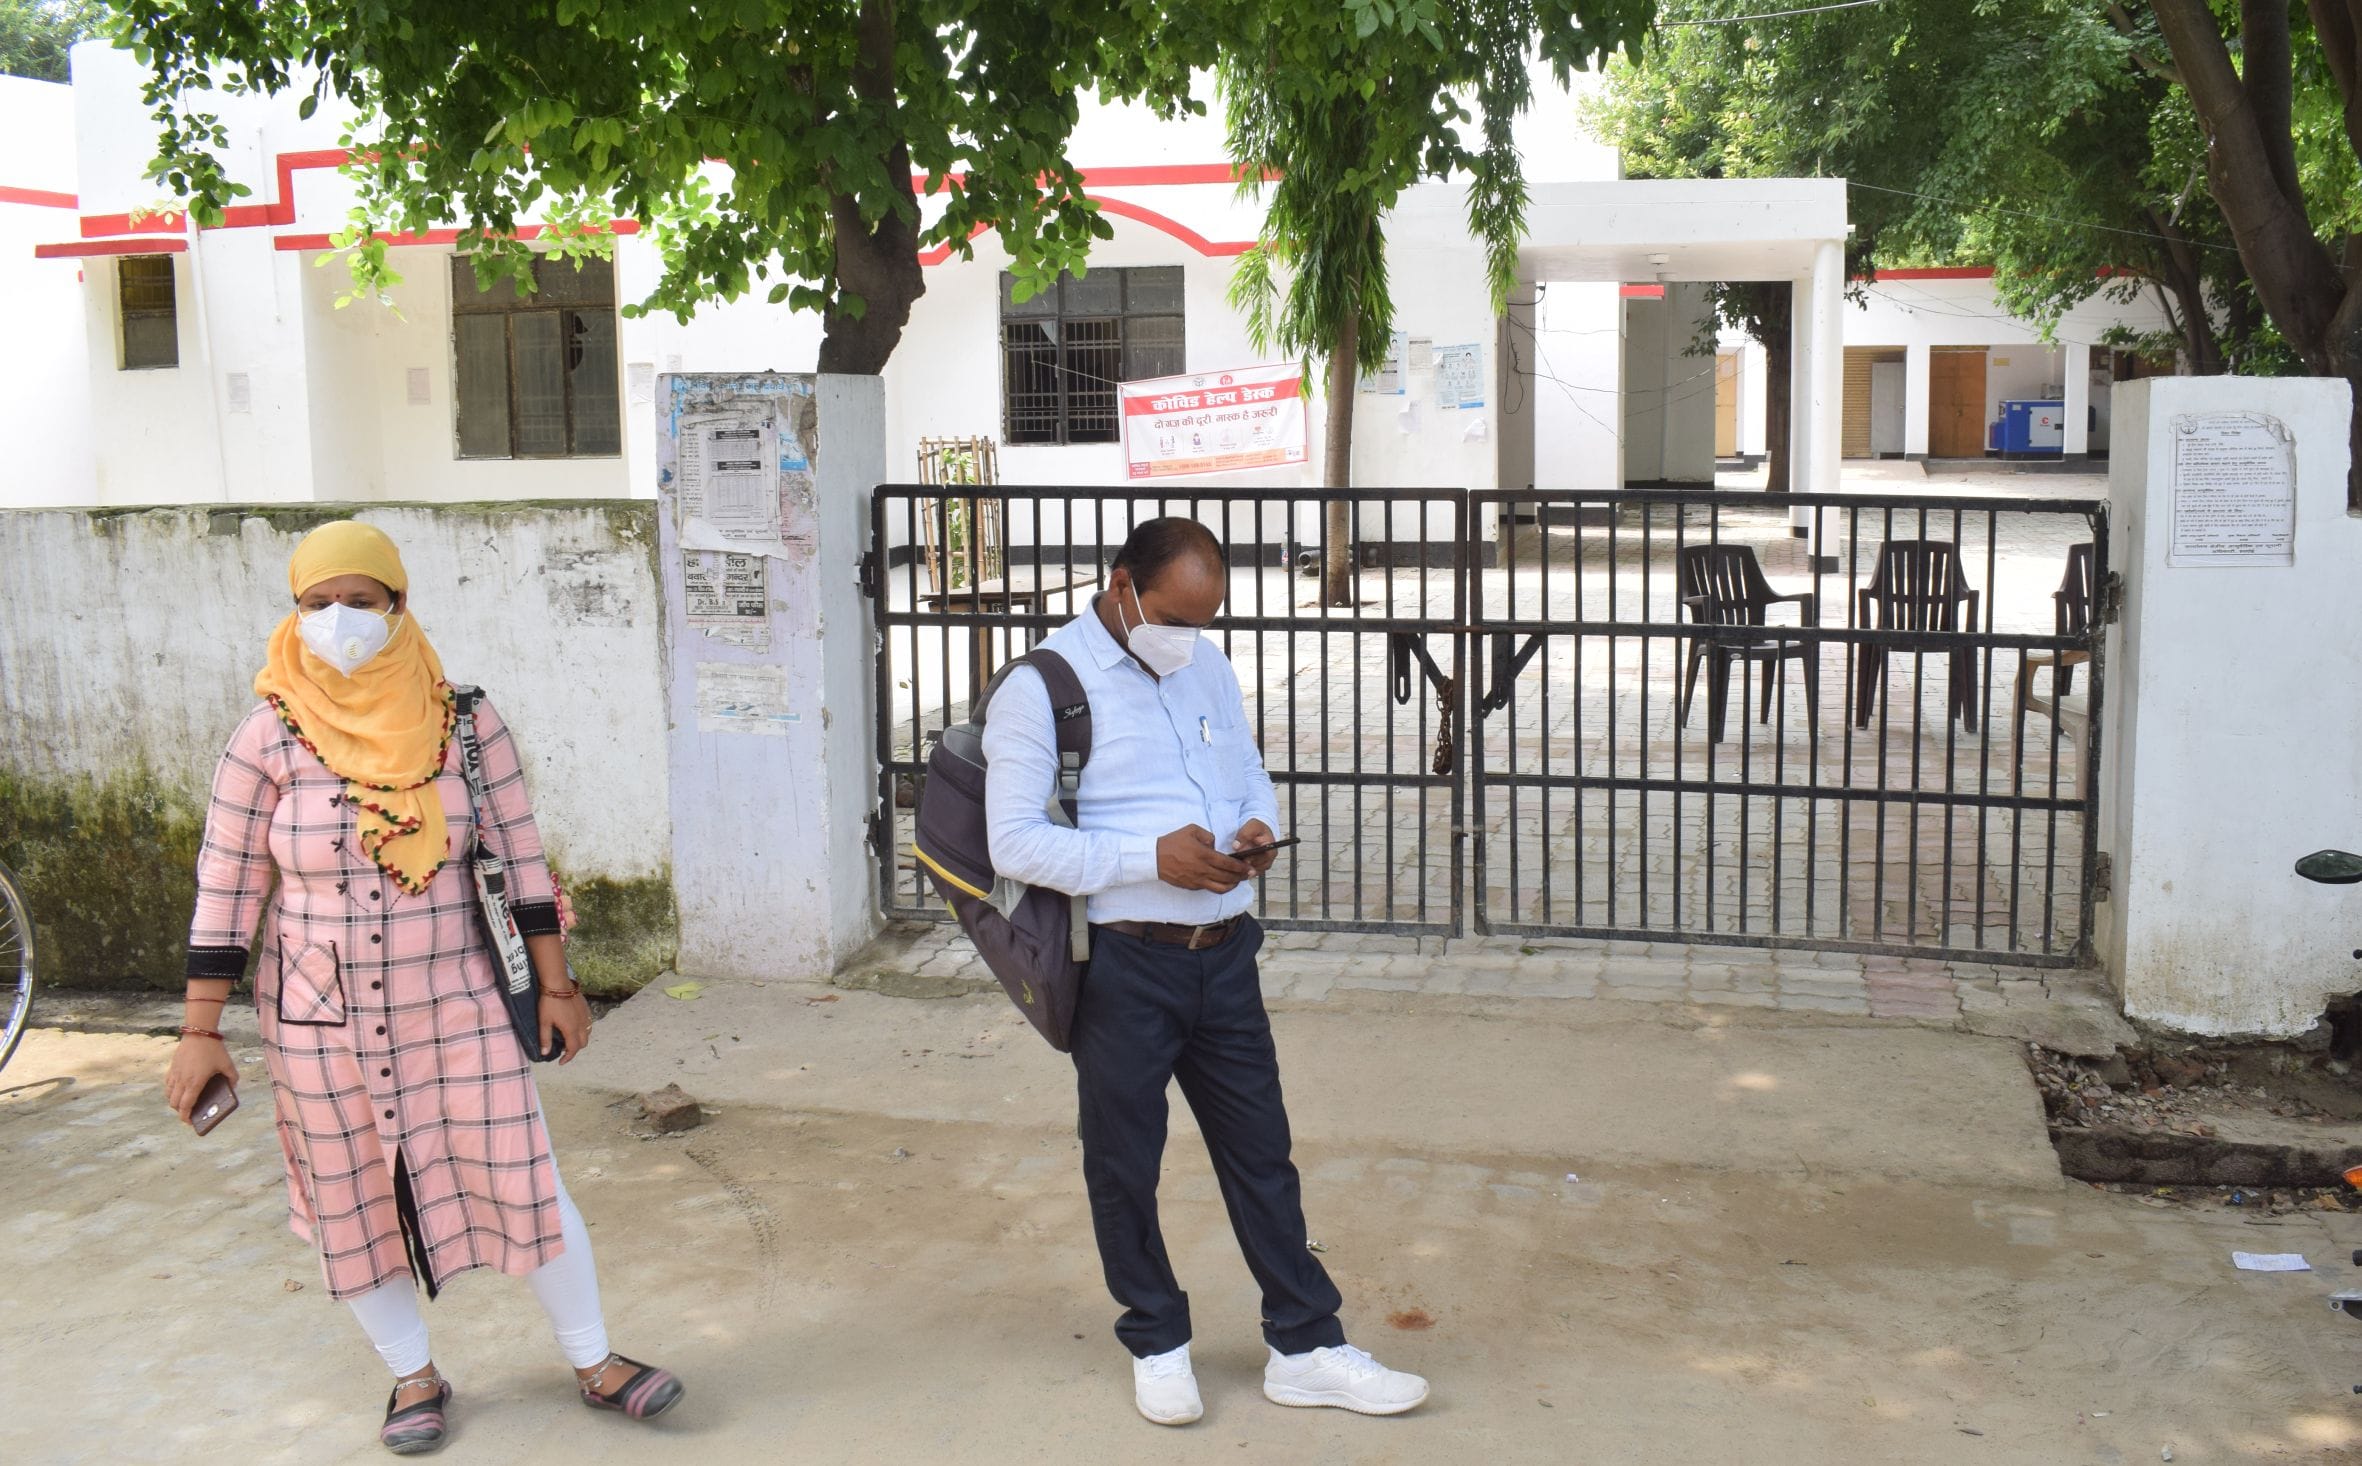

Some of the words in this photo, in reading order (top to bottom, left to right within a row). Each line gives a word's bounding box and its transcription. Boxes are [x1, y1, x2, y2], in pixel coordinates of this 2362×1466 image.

[1151, 395, 1200, 411] कोविड
[1203, 391, 1237, 405] हेल्प
[1241, 386, 1276, 401] डेस्क
[1182, 415, 1194, 427] की
[1196, 414, 1211, 427] दूरी
[1216, 412, 1240, 423] मास्क
[1242, 410, 1250, 420] है
